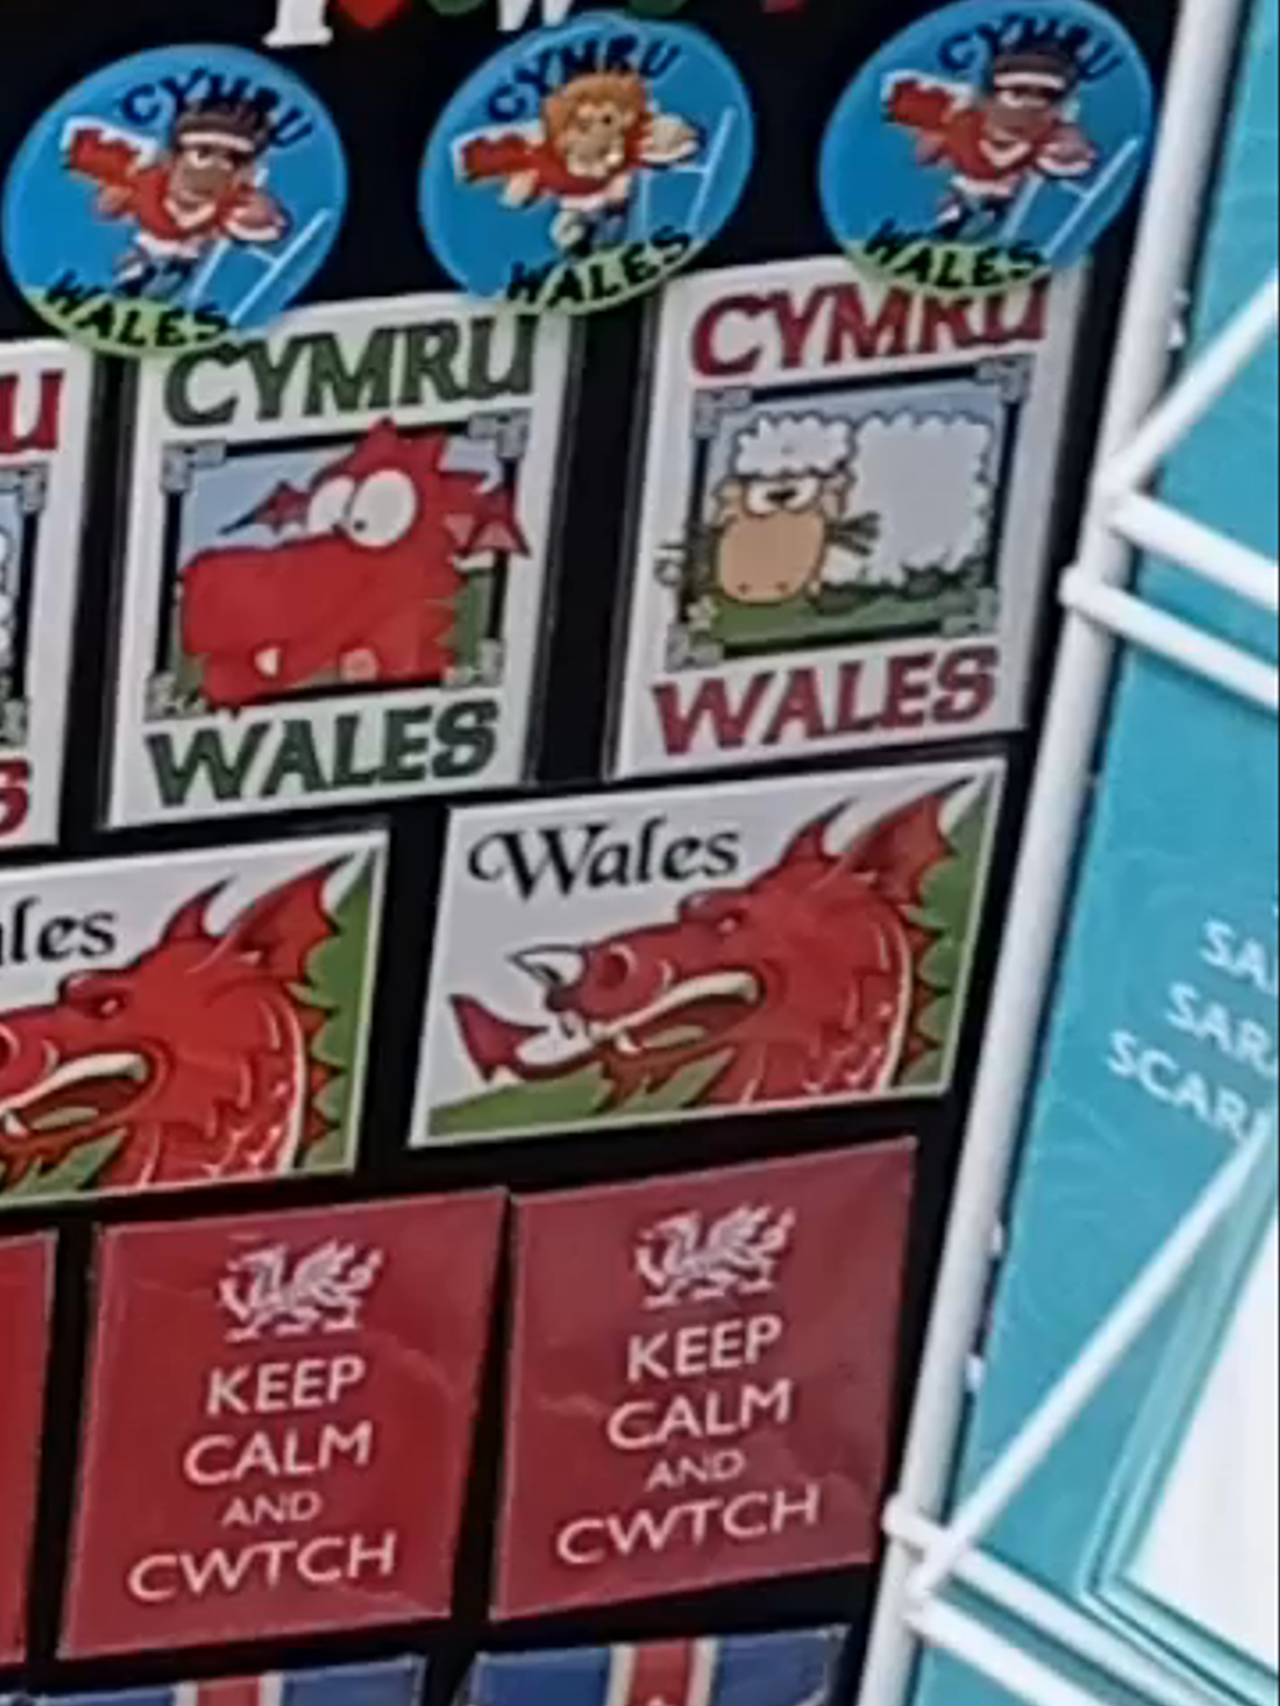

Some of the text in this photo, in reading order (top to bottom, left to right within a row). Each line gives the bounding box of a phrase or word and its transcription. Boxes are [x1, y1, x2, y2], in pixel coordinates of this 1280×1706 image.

[501, 219, 697, 309] WALES
[860, 212, 1044, 291] WALES
[43, 268, 232, 349] WALES
[161, 311, 535, 427] CYMRU
[651, 646, 1000, 756] WALES
[143, 699, 500, 808] WALES
[465, 810, 743, 902] Wales
[1200, 918, 1279, 996] SA
[1166, 983, 1279, 1076] SAR
[206, 1356, 366, 1417] KEEP
[626, 1315, 784, 1385] KEEP
[183, 1421, 375, 1486] CALM
[607, 1380, 793, 1452] CALM
[644, 1449, 745, 1491] AND
[221, 1490, 324, 1530] AND
[556, 1486, 823, 1568] CWTCH
[127, 1532, 399, 1602] CWTCH
